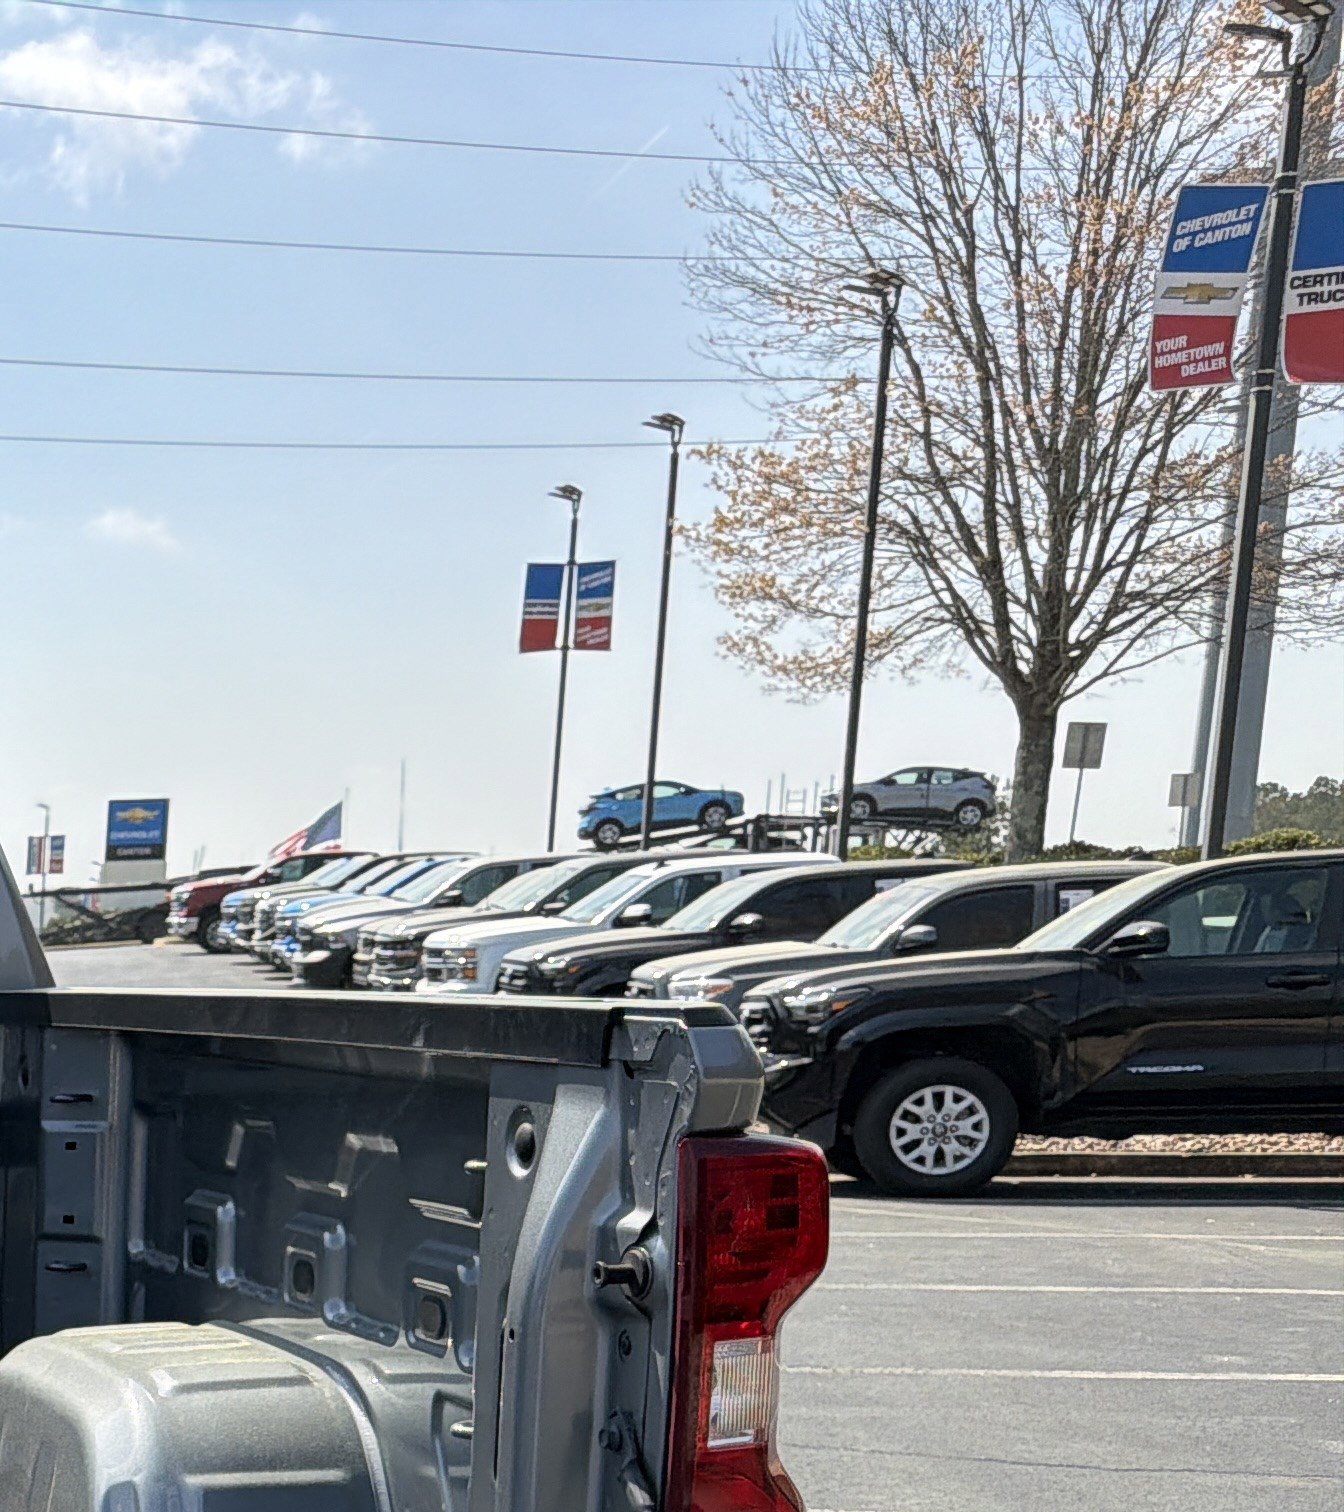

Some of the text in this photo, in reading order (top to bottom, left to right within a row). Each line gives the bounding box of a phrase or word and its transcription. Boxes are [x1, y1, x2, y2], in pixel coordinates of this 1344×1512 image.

[1176, 203, 1259, 236] CHEVROLET
[1172, 221, 1253, 252] OF CANTON
[1289, 271, 1344, 290] CERTI
[1154, 335, 1188, 354] YOUR
[1154, 341, 1225, 368] HOMETOWN
[1180, 356, 1227, 378] DEALER
